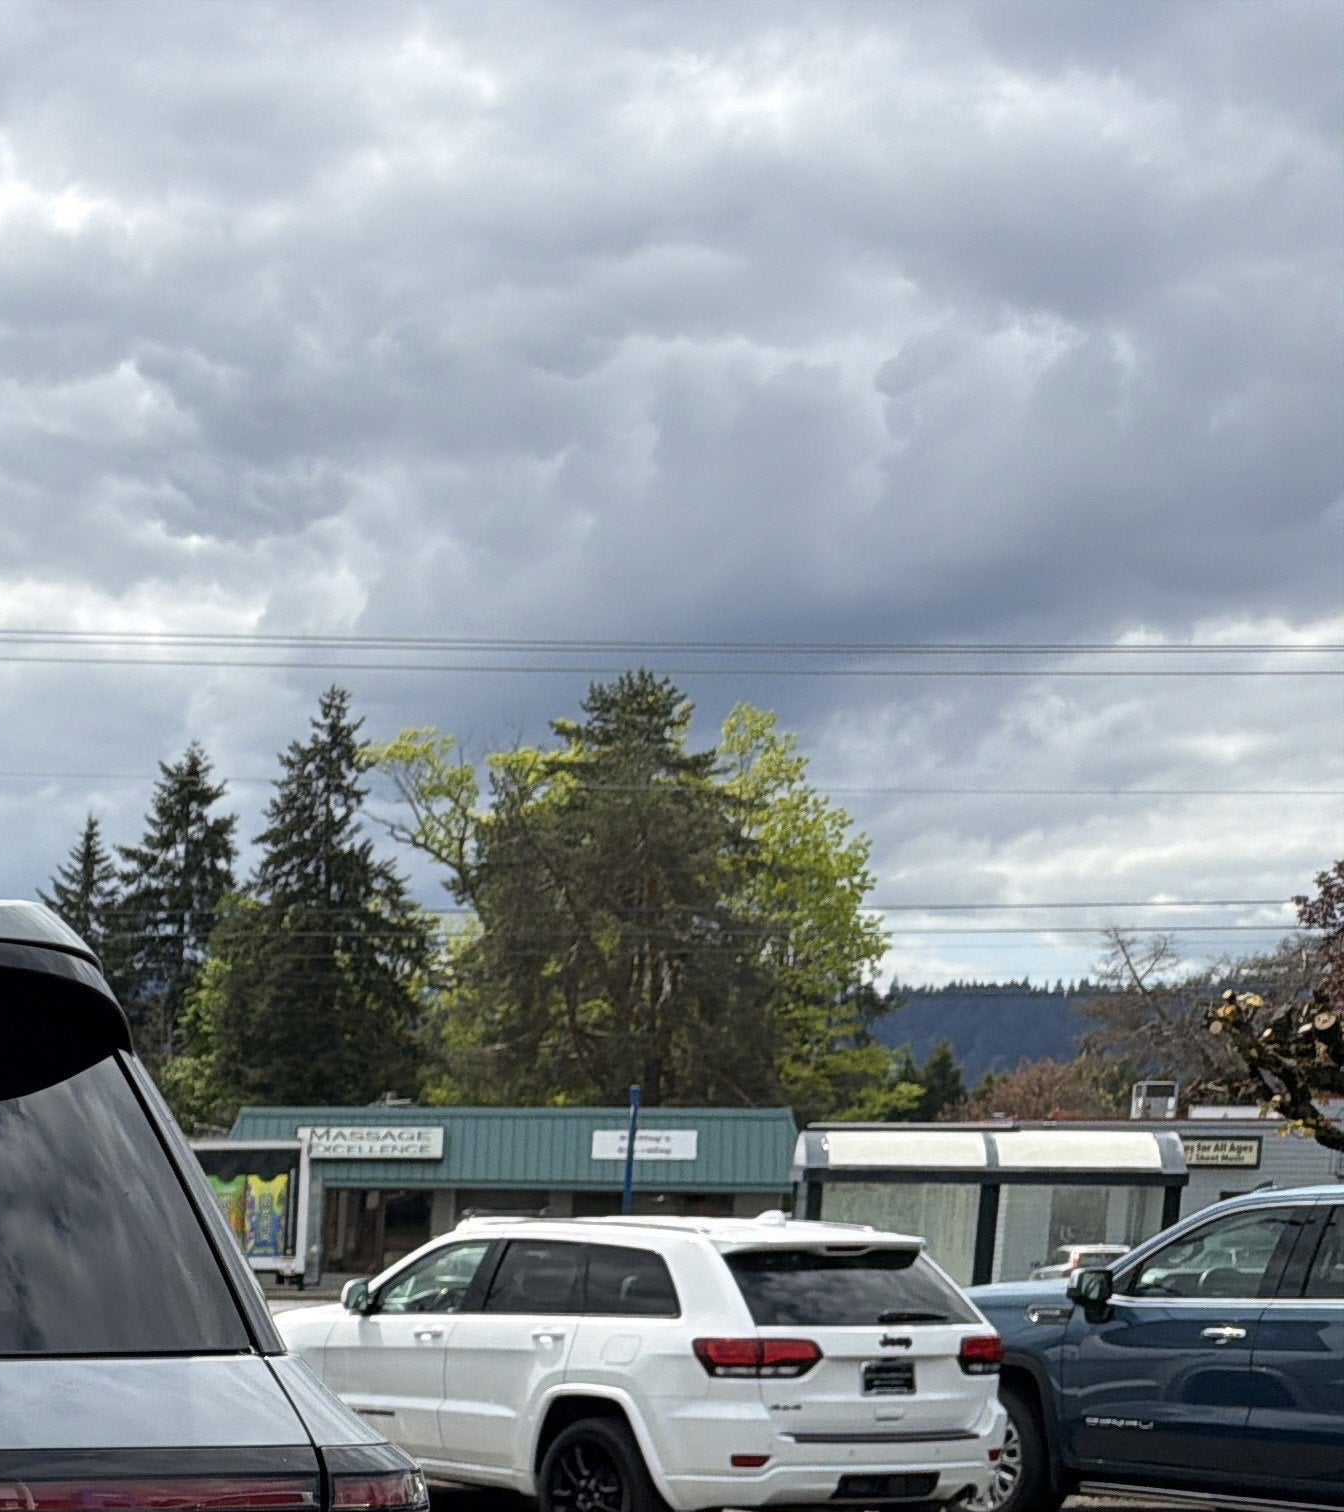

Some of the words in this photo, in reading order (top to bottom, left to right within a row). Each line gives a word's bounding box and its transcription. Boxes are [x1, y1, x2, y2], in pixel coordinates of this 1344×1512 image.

[311, 1128, 432, 1143] MASSAGE
[1214, 1142, 1227, 1152] All
[1229, 1143, 1253, 1154] Ages
